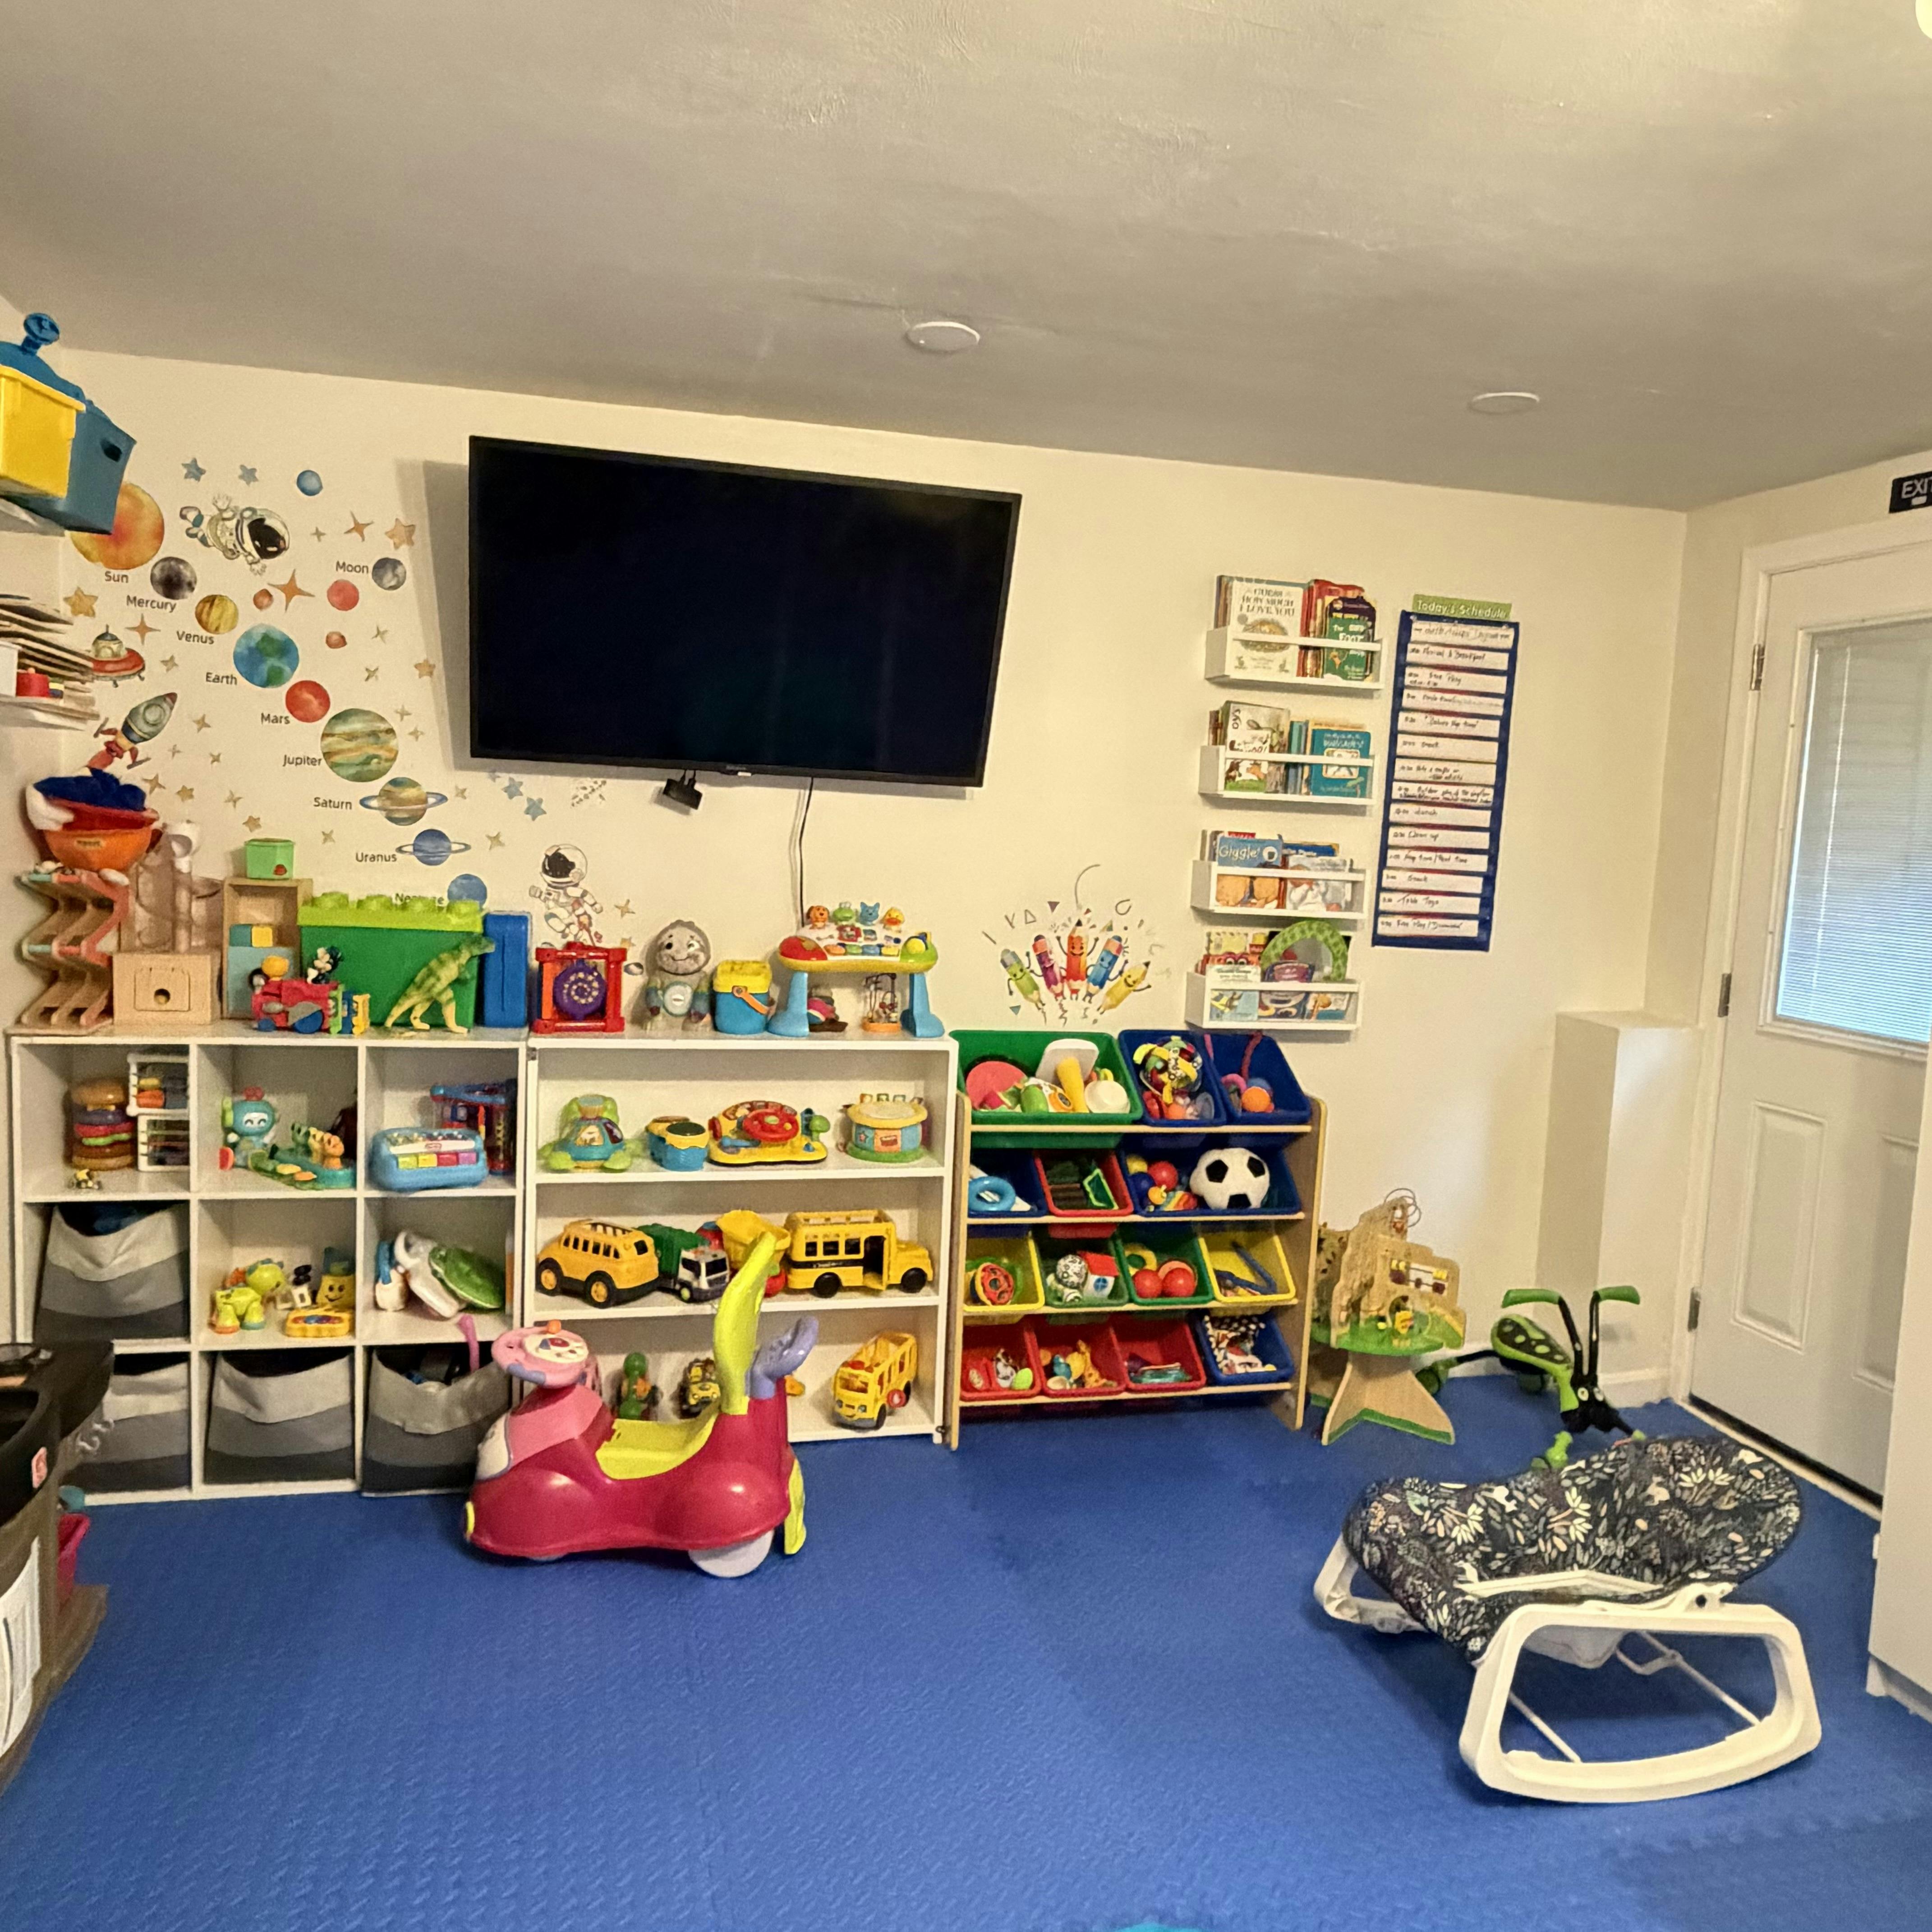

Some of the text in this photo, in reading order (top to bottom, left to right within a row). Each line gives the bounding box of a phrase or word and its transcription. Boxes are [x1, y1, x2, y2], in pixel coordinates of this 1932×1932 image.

[336, 561, 369, 574] Moon
[105, 571, 129, 584] Sun
[126, 595, 177, 613] Mercury
[1275, 607, 1295, 616] YOU
[1459, 605, 1507, 619] Schedule
[176, 630, 215, 644] Venus
[206, 672, 238, 685] Earth
[261, 713, 291, 725] Mars
[283, 754, 322, 767] Jupiter
[313, 797, 352, 810] Saturn
[355, 852, 397, 864] Uranus
